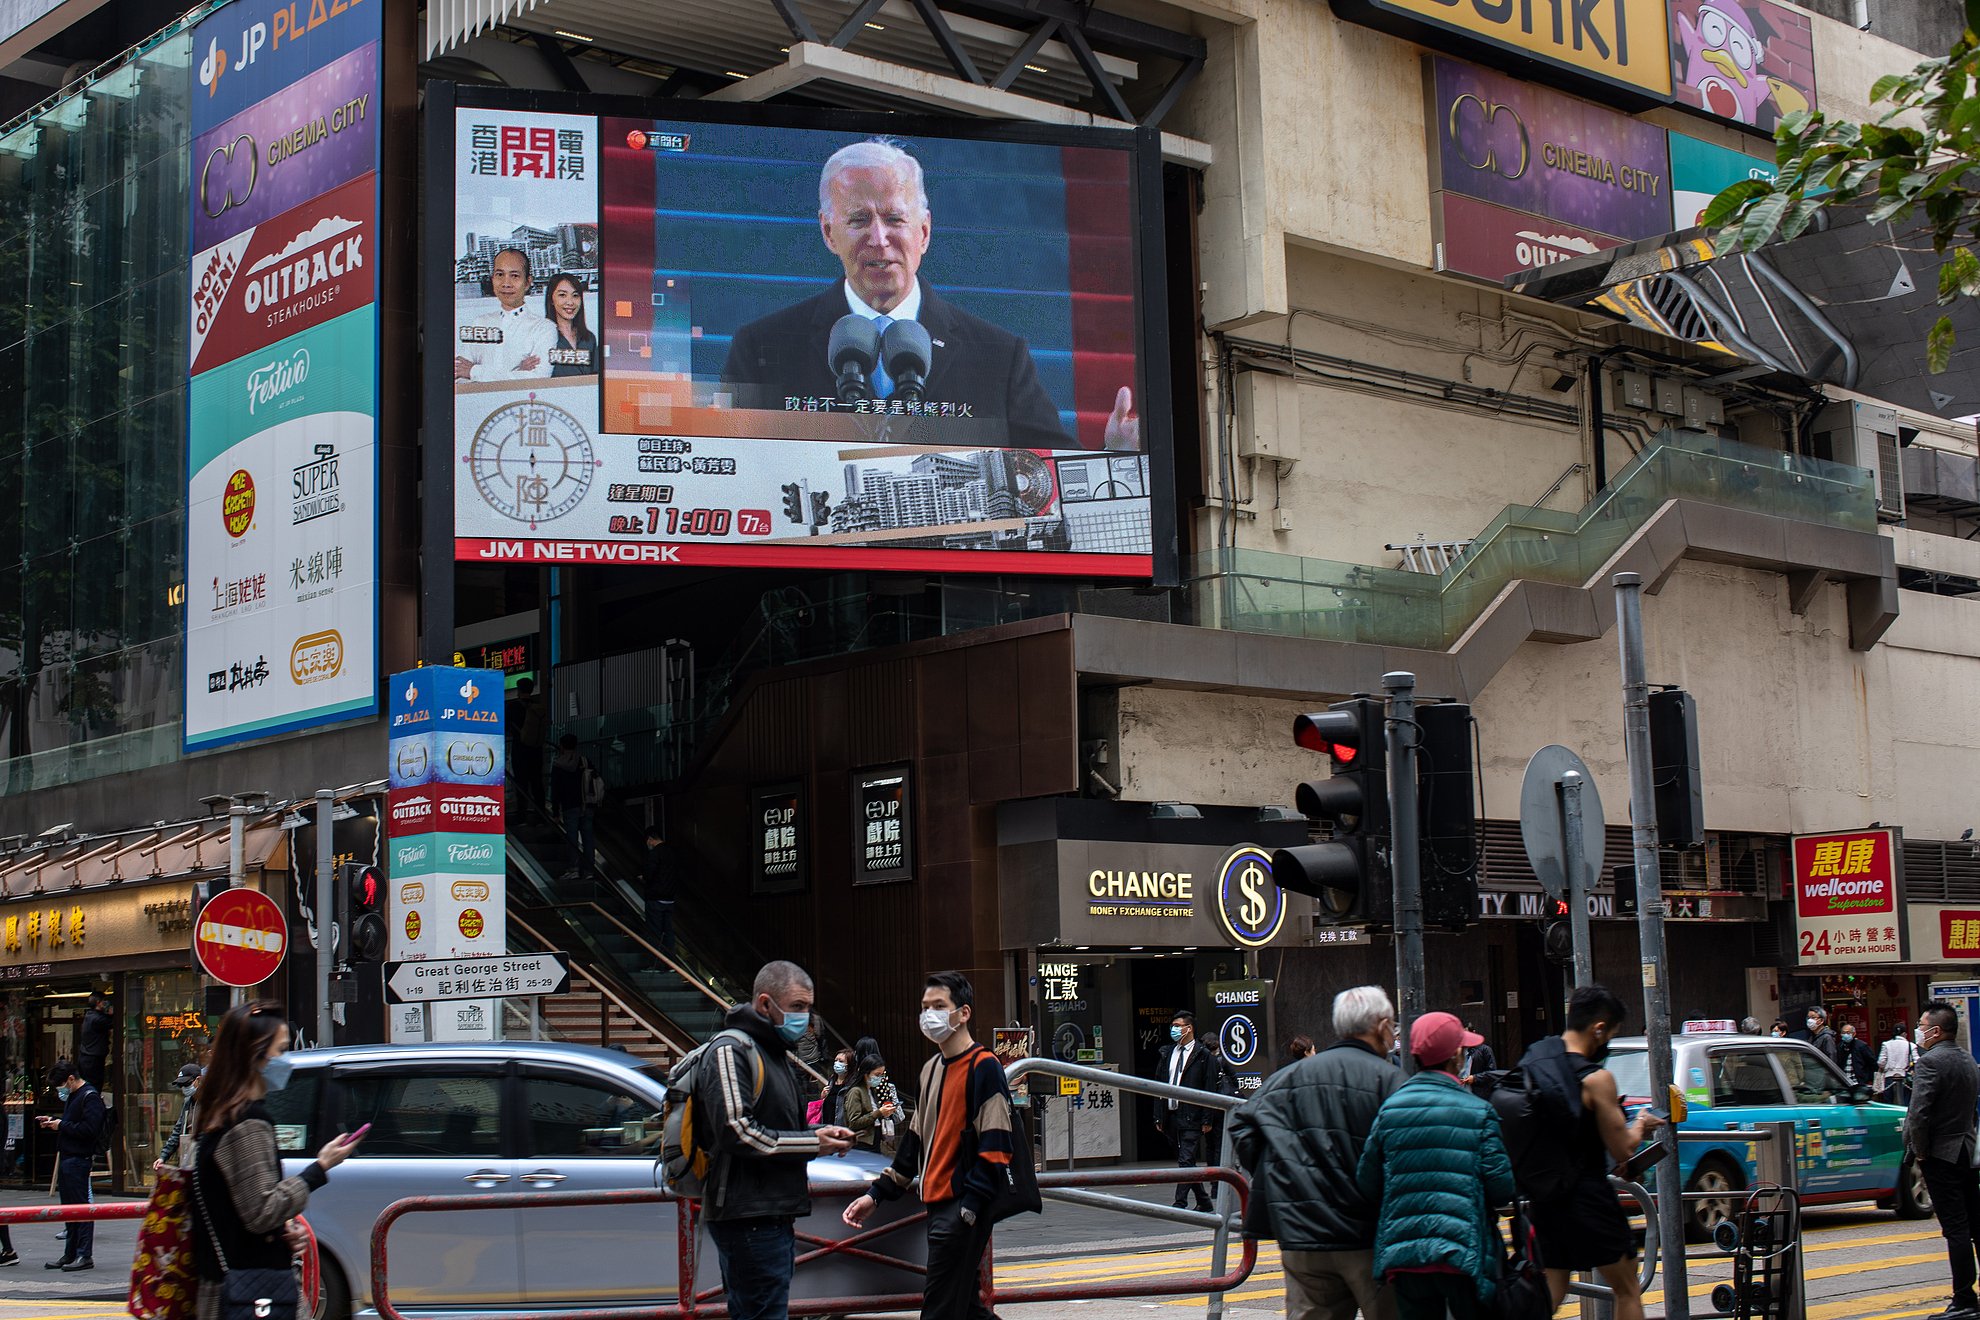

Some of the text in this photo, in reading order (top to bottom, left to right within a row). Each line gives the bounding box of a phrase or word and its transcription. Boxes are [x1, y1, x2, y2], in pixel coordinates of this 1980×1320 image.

[234, 0, 363, 71] JP PLAZ
[267, 94, 368, 166] CINEMA CITY
[1541, 142, 1659, 196] CINEMA CITY
[192, 248, 223, 309] NOW
[244, 234, 363, 314] OUTBACK
[246, 348, 311, 416] Festiva
[293, 459, 339, 500] SUPER
[608, 484, 674, 503] 逢星期日
[293, 493, 340, 521] SANDWICHES
[646, 507, 732, 535] 11:00
[479, 541, 681, 562] JM NETWORK
[288, 546, 343, 591] 米線陣
[211, 573, 266, 612] 上海姥姥
[393, 709, 430, 727] JP PLAZA
[440, 709, 499, 722] JP PLAZA
[392, 803, 432, 820] OUTBACK
[440, 802, 500, 816] OUTBACK
[781, 808, 795, 824] JP
[885, 800, 900, 817] JP
[867, 819, 901, 844] 戲院
[398, 843, 428, 868] Festiva
[447, 844, 494, 863] Festiva
[1809, 838, 1876, 877] 惠康
[1089, 869, 1193, 899] CHANGE
[1805, 878, 1884, 897] wellcome
[1090, 906, 1194, 917] MONEY EXCHANGE CENTRE
[1827, 896, 1885, 911] Superstore
[1800, 927, 1896, 956] 24 小時營業
[1834, 944, 1896, 955] OPEN 24 HOURS
[415, 960, 541, 978] Great George Street
[406, 977, 553, 995] 1-19 記利佐治街 25-29
[1044, 978, 1078, 1000] 汇款
[1215, 991, 1259, 1004] CHANGE
[457, 1010, 484, 1022] SUPER
[1687, 1021, 1726, 1032] TAXI
